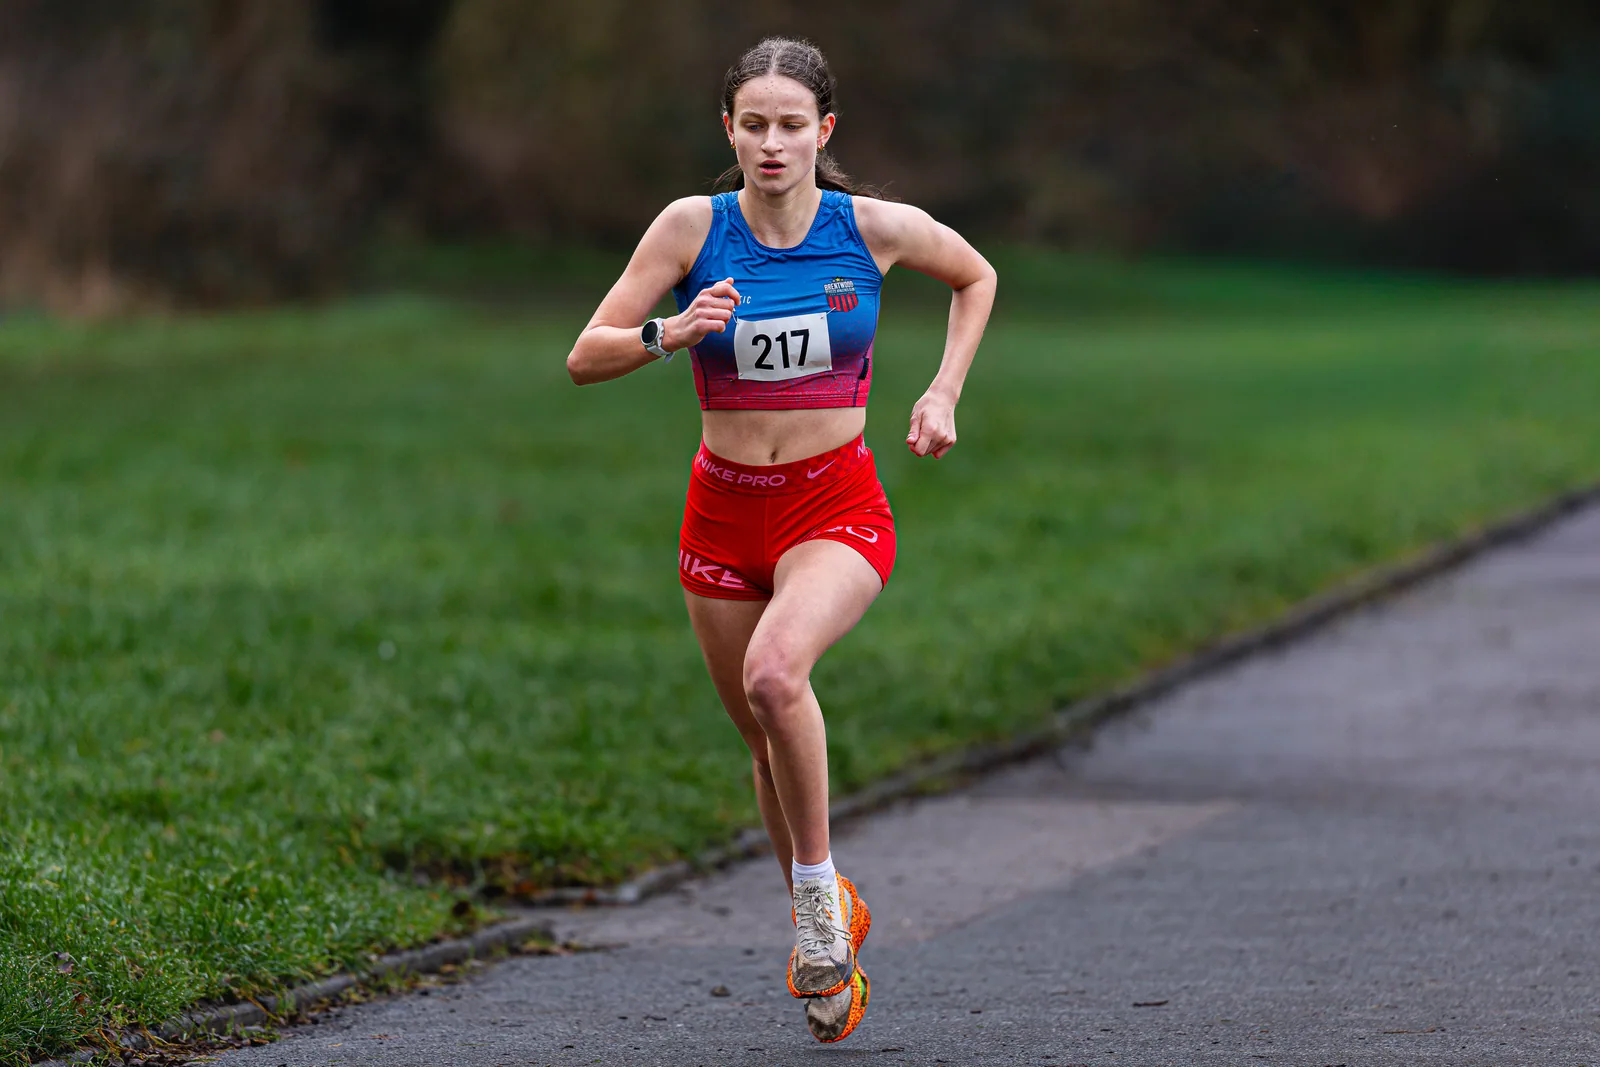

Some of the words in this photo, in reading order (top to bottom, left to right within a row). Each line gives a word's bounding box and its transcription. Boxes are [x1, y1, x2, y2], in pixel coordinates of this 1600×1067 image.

[751, 328, 810, 371] 217
[697, 453, 737, 482] NIKE
[737, 473, 786, 487] PRO
